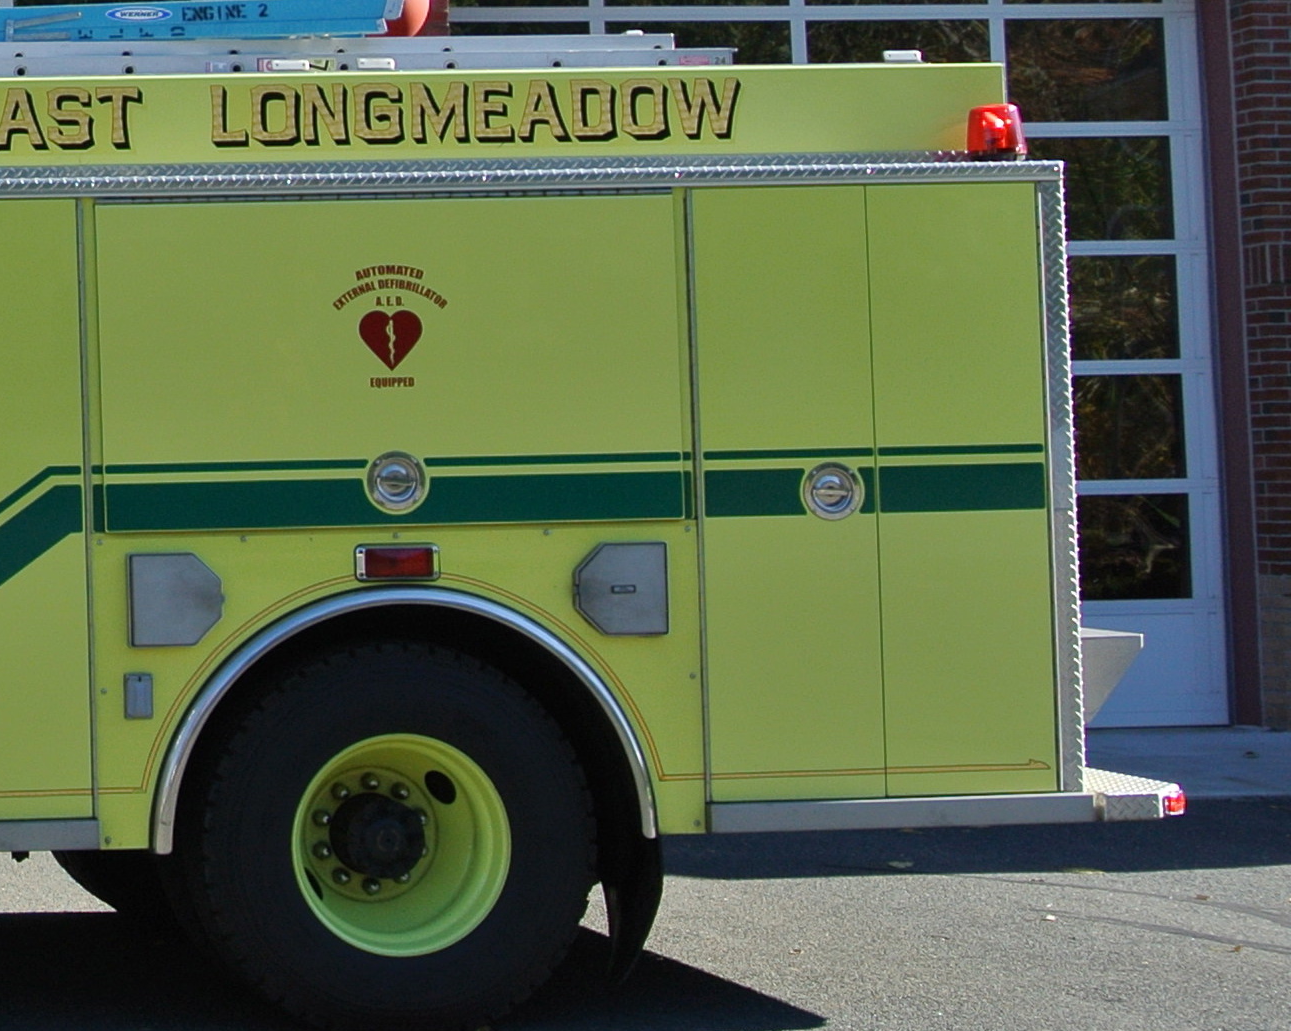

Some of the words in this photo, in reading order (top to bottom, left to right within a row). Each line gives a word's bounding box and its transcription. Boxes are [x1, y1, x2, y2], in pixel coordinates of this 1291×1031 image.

[119, 11, 160, 19] WERNER
[181, 4, 247, 22] ENGINE
[258, 3, 269, 18] 2
[714, 56, 726, 65] 24
[210, 79, 742, 150] LONGMEADOW
[355, 265, 425, 281] AUTOMATED
[332, 281, 377, 311] EXTERNAL
[377, 279, 448, 309] DEFIBRILLATOR
[370, 377, 415, 389] EQUIPPED
